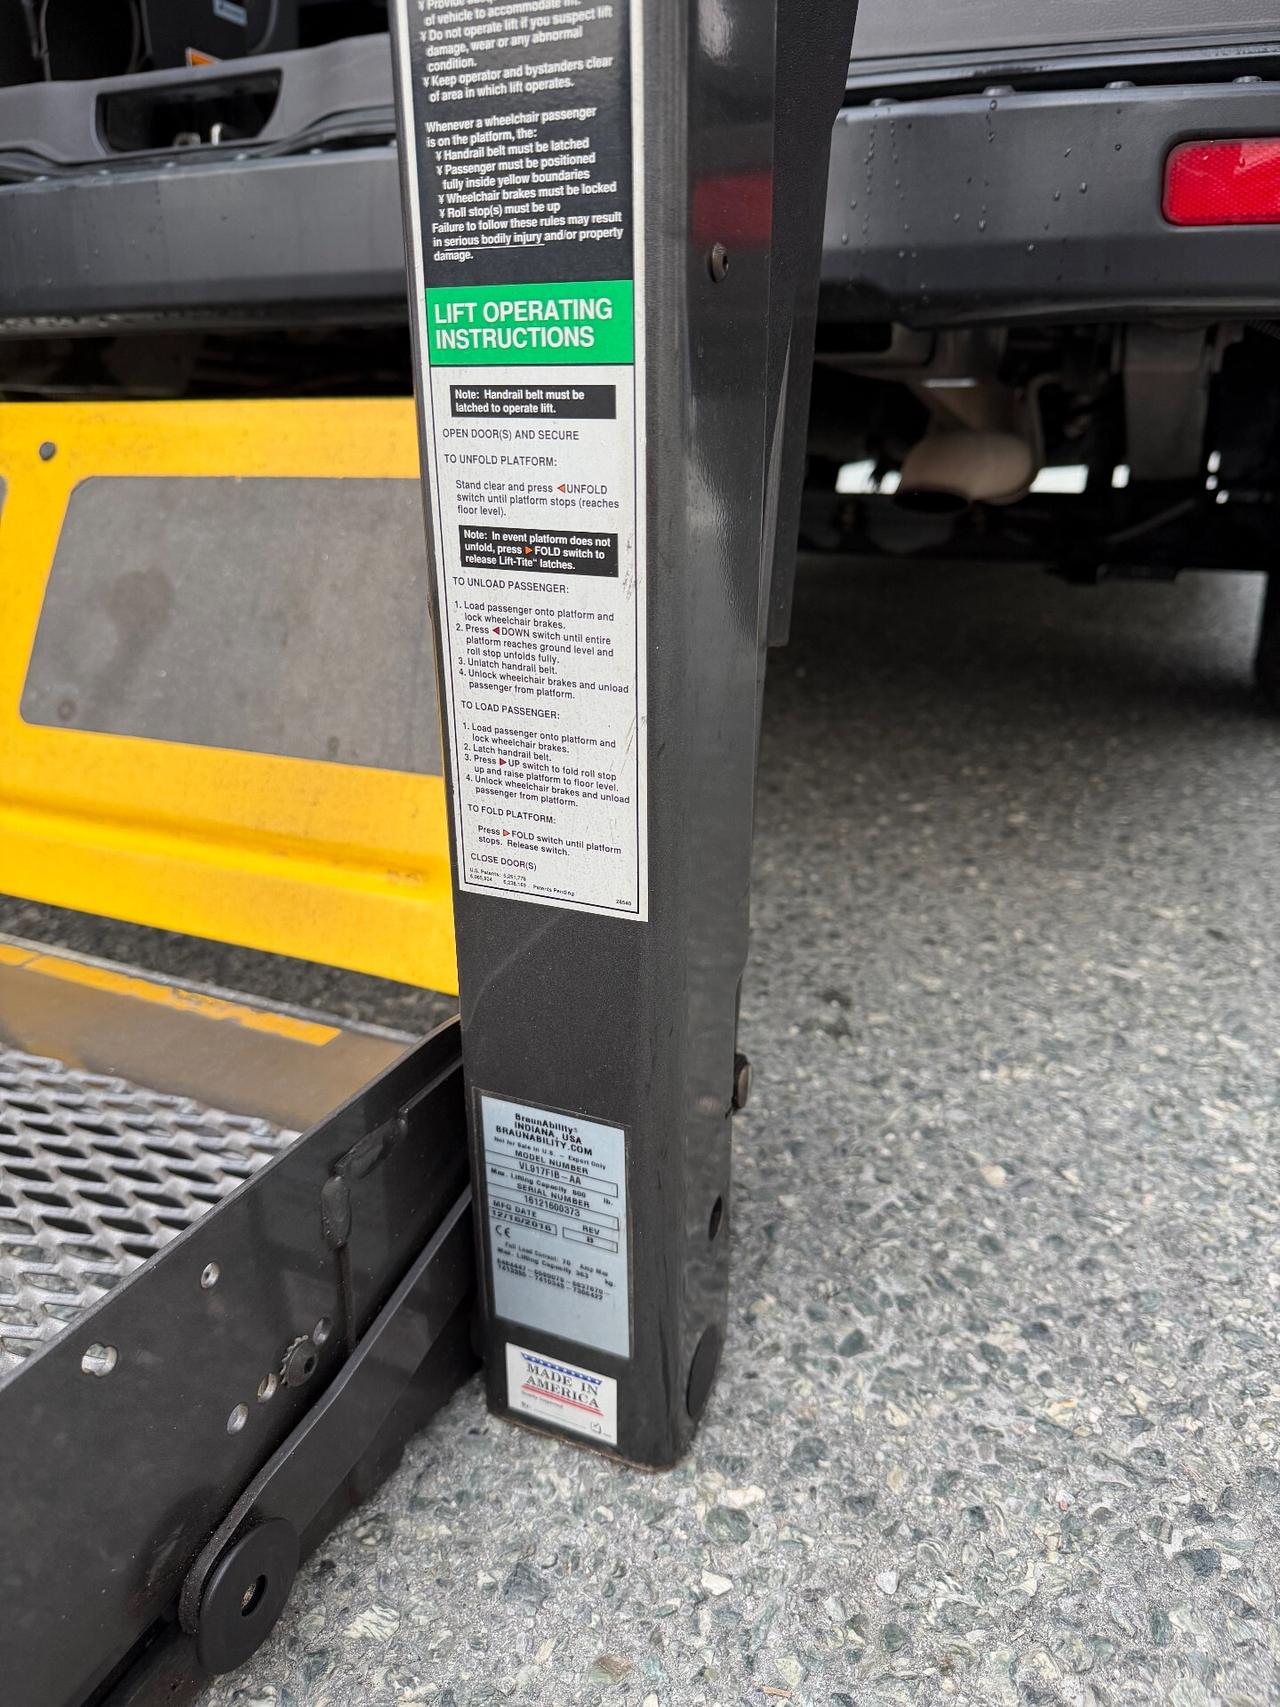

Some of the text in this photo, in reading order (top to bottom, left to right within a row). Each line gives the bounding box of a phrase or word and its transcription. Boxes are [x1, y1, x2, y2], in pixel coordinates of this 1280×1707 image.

[426, 108, 597, 132] Whenever a wheelchair passenger
[427, 127, 537, 147] is on the platform, the:
[444, 136, 589, 160] Handrail belt must be latched
[445, 151, 596, 175] Passenger must be positioned
[442, 168, 591, 191] fully inside yellow boundaries
[446, 181, 617, 203] Wheelchair brakes must be locked
[432, 211, 622, 233] Failure to follow these rules may result
[435, 298, 612, 323] LIFT OPERATING
[436, 326, 594, 349] INSTRUCTIONS
[455, 389, 585, 399] Note: Handrail belt must be
[456, 402, 556, 415] latched to operate lift.
[442, 428, 579, 440] OPEN DOOR(S) AND SECURE
[444, 454, 557, 466] TO UNFOLD PLATFORM:
[456, 480, 608, 494] Stand clear and press UNFOLD
[457, 492, 620, 508] switch until platform stops (reaches
[457, 504, 506, 517] floor level).
[464, 529, 611, 546] Note: In event platform does not
[465, 542, 605, 559] unfold, press FOLD switch to
[465, 554, 497, 564] release
[540, 558, 576, 569] latches.
[452, 577, 569, 594] TO UNLOAD PASSENGER:
[458, 657, 557, 674] 3. Unlatch handrail belt.
[459, 668, 629, 693] 4. Unlock wheelchair brakes and unload
[461, 700, 560, 719] TO LOAD PASSENGER:
[468, 804, 556, 824] TO FOLD PLATFORM:
[478, 824, 621, 854] Press FOLD switch until platform
[478, 835, 570, 856] stops. Release switch.
[470, 852, 537, 872] CLOSE DOOR(S)
[496, 1125, 592, 1156] BRAUNABILITY.COM
[562, 1133, 582, 1145] USA
[515, 1150, 589, 1174] MODEL NUMBER
[568, 1156, 589, 1165] Export
[591, 1161, 606, 1170] Only
[510, 1173, 534, 1185] Lifting
[536, 1180, 567, 1194] Capacity
[517, 1183, 590, 1208] SERIAL NUMBER
[493, 1200, 600, 1235] MFG DATE REV
[527, 1363, 598, 1396] MADE IN
[526, 1376, 600, 1408] AMERICA
